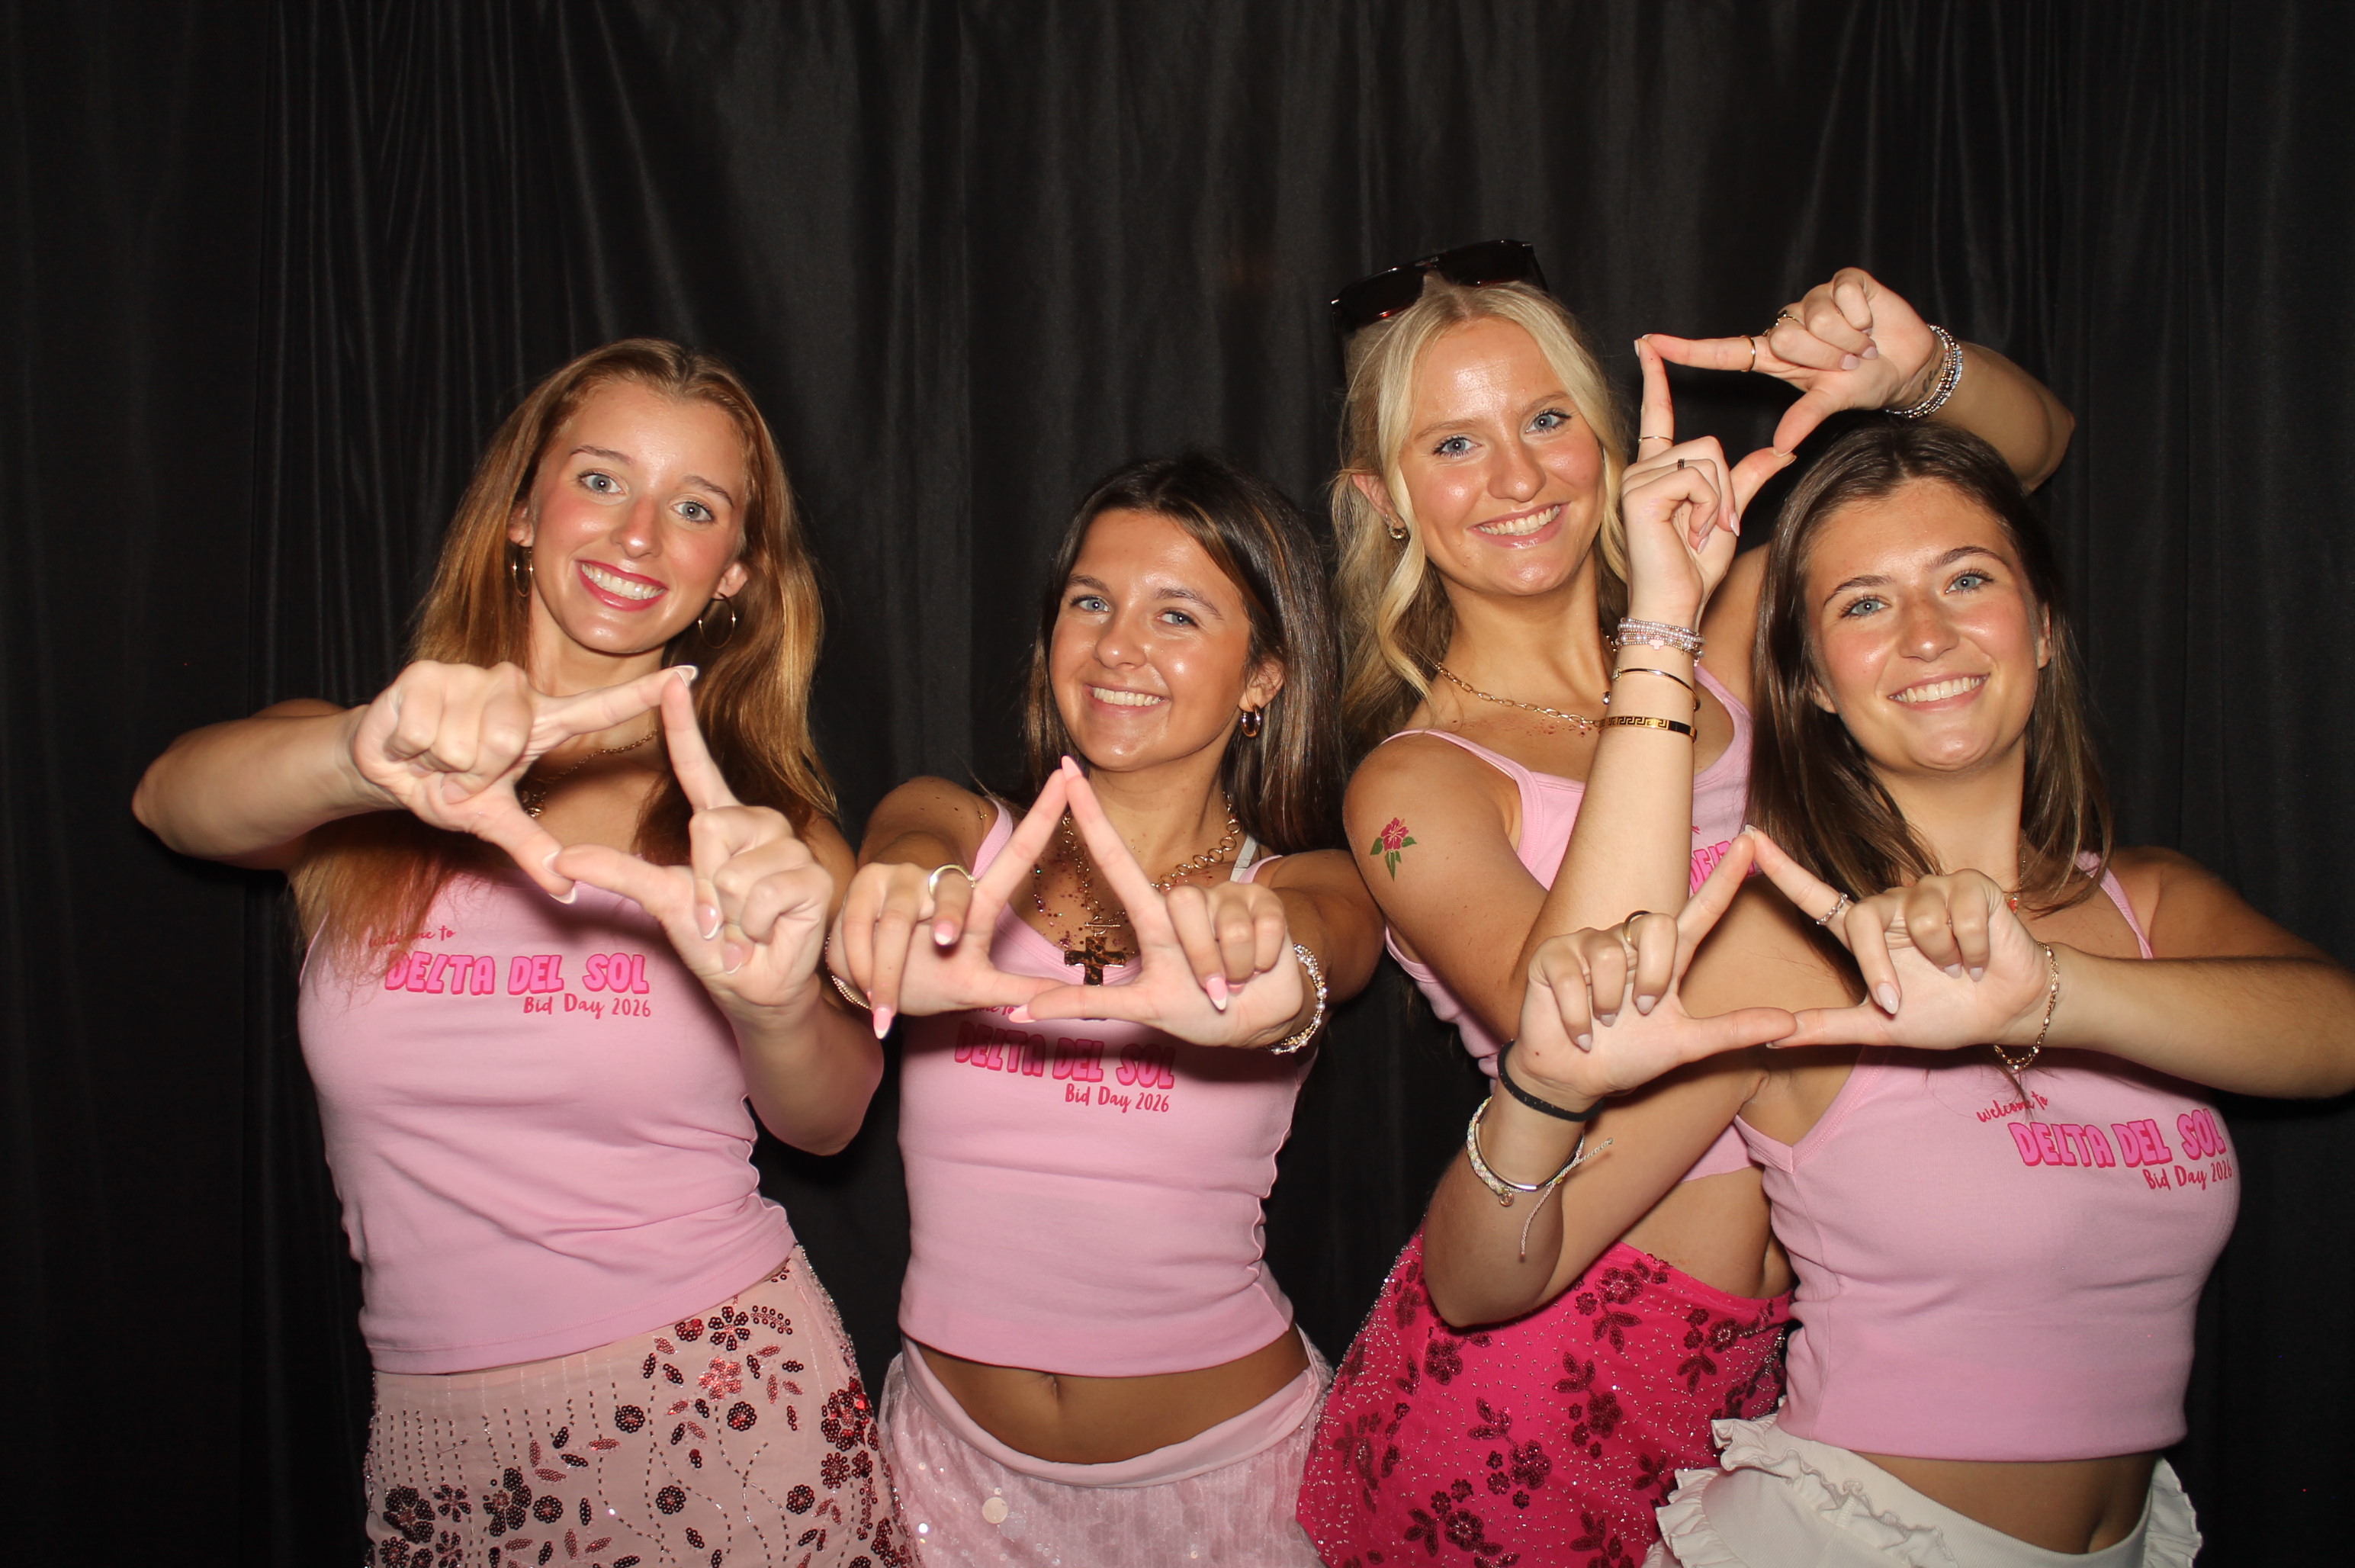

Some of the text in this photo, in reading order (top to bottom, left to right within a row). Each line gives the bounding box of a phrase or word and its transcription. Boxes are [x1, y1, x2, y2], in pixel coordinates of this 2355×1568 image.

[439, 925, 456, 941] to
[385, 950, 649, 995] DELTA DEL SOL
[523, 993, 651, 1019] Bid Day 2026
[954, 1021, 1176, 1089] DELTA DEL SOL
[1065, 1084, 1169, 1113] Bid Day 2026
[2031, 1091, 2048, 1110] to
[2007, 1108, 2226, 1168] DELTA DEL SOL
[2142, 1159, 2232, 1190] Bid Day 2026
